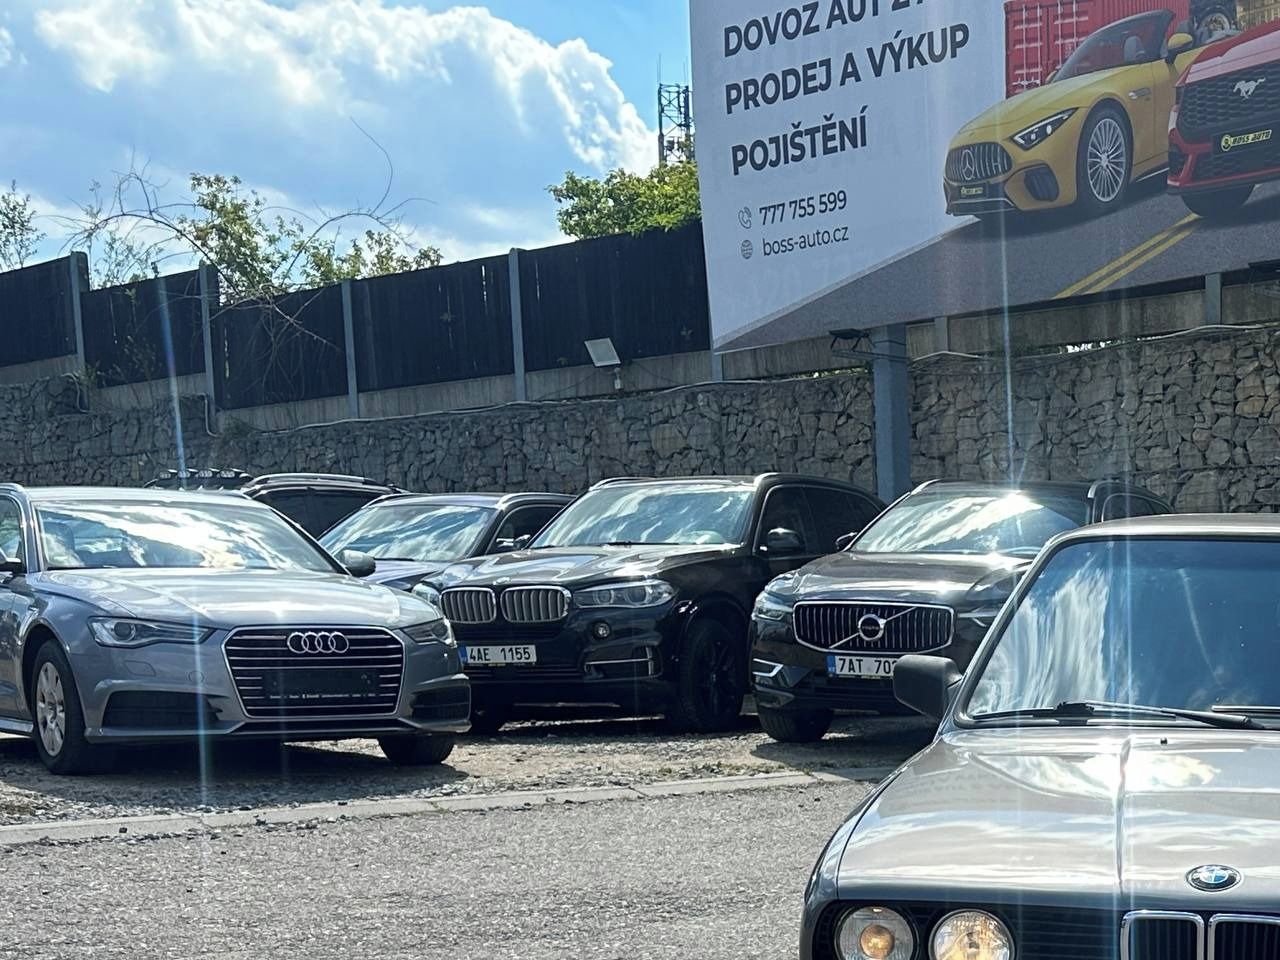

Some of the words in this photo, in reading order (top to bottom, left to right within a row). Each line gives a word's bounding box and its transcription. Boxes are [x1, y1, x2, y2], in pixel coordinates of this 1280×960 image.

[724, 1, 819, 57] DOVOZ
[725, 58, 832, 115] PRODEJ
[840, 52, 862, 86] A
[867, 23, 970, 78] VÝKUP
[732, 105, 868, 176] POJIŠTĚNÍ
[759, 203, 785, 226] 777
[789, 197, 815, 220] 755
[819, 190, 847, 214] 599
[762, 226, 849, 256] boss-auto.cz
[469, 647, 491, 662] 4AE
[500, 646, 531, 661] 1155
[838, 658, 863, 673] 7AT
